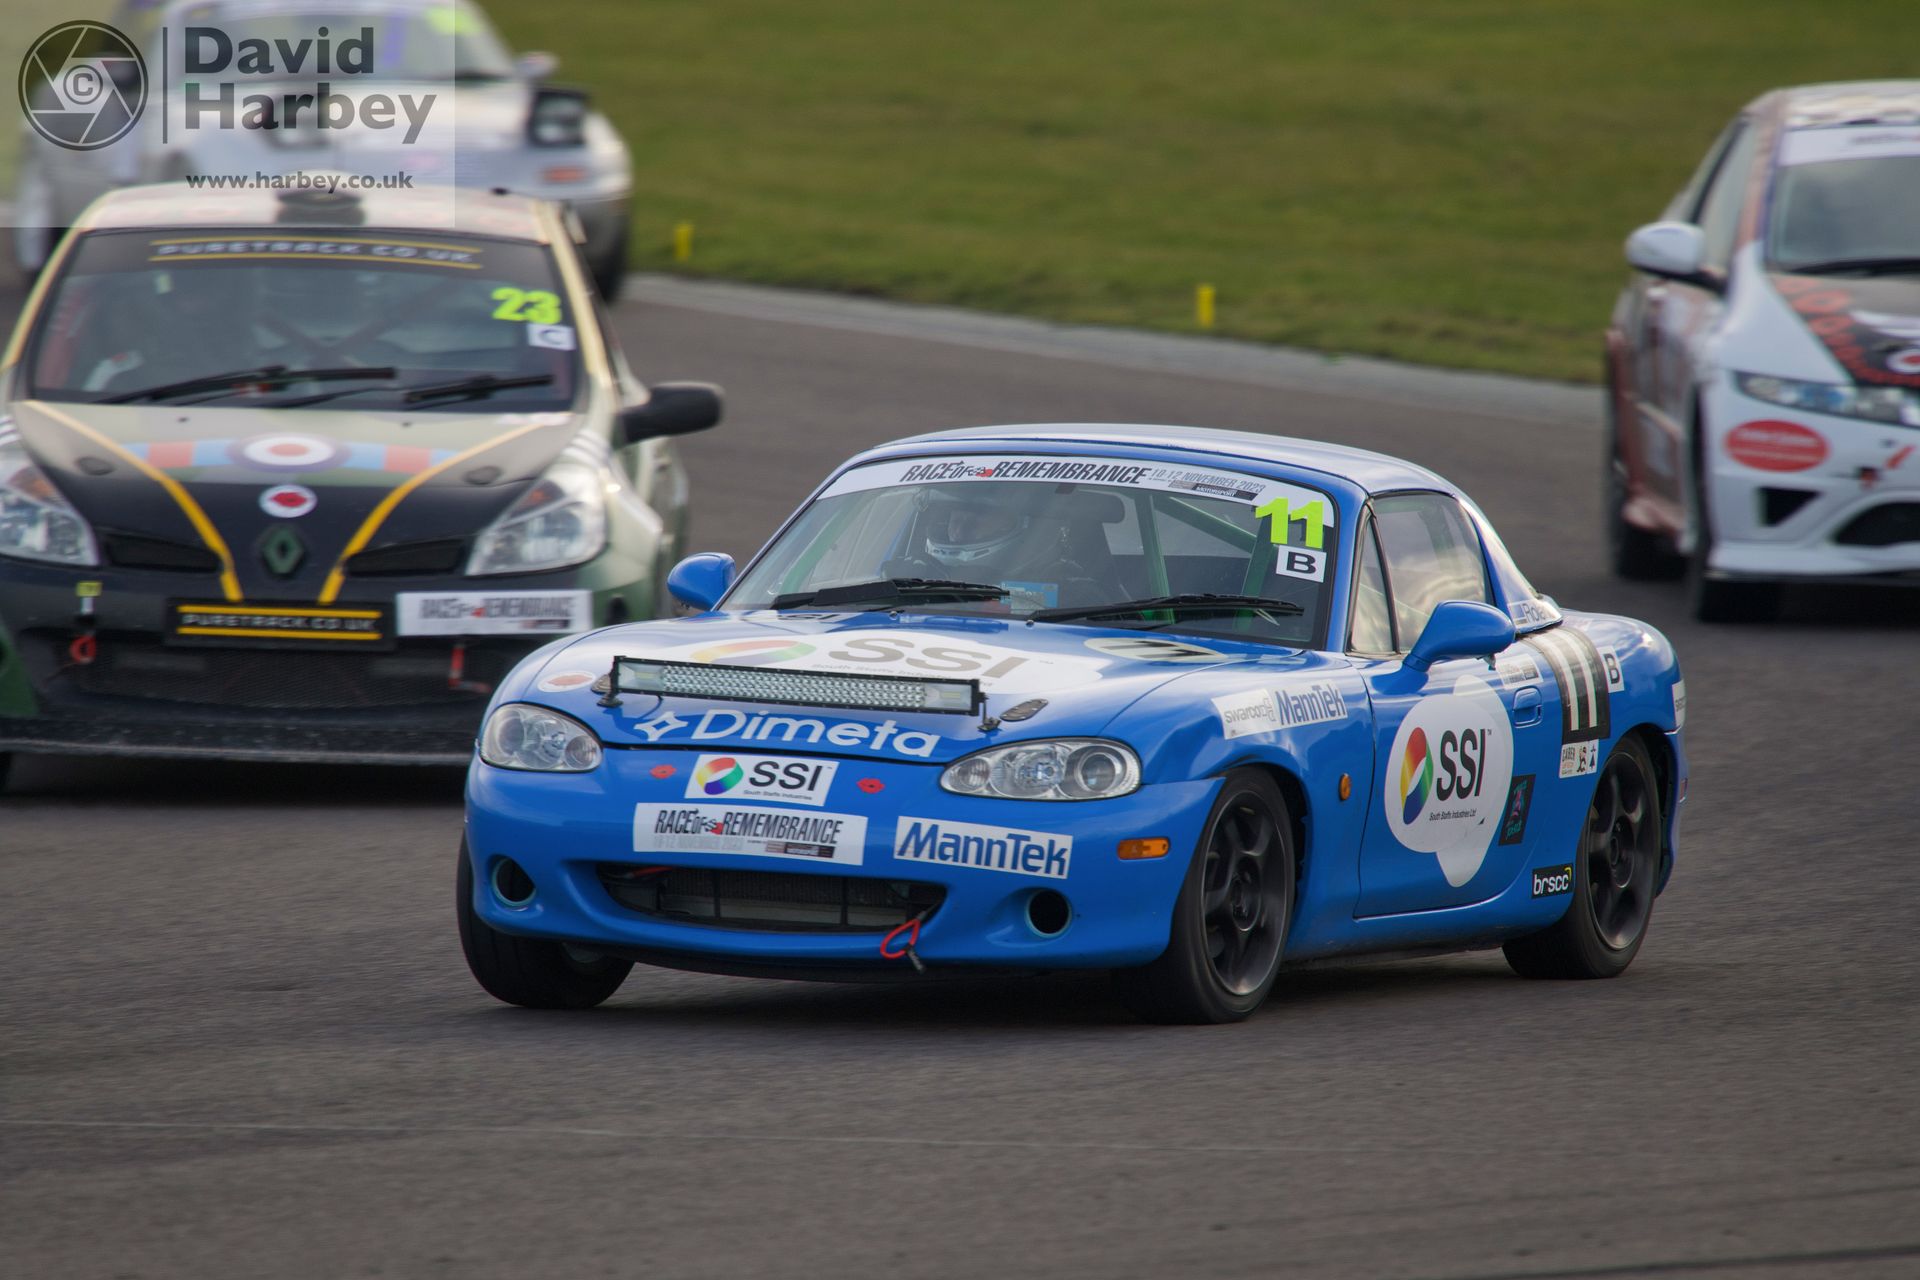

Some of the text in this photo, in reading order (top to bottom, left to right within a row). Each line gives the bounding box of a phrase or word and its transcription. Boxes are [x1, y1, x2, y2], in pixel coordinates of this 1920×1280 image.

[491, 287, 561, 325] 23
[900, 461, 958, 482] RACE
[992, 461, 1152, 485] REMEMBRANCE
[1183, 472, 1238, 487] NOVEMBER
[1237, 480, 1266, 493] 2023
[1255, 497, 1324, 549] 11
[1286, 551, 1317, 575] B
[829, 637, 1030, 679] SSI
[1603, 653, 1620, 685] B
[1275, 684, 1346, 726] MannTek
[691, 710, 941, 758] Dimeta
[749, 761, 823, 792] SSI
[1436, 728, 1486, 802] SSI
[654, 810, 695, 834] RACE
[721, 811, 844, 845] REMEMBRANCE
[897, 822, 1068, 877] MannTek
[1533, 873, 1569, 896] brscc
